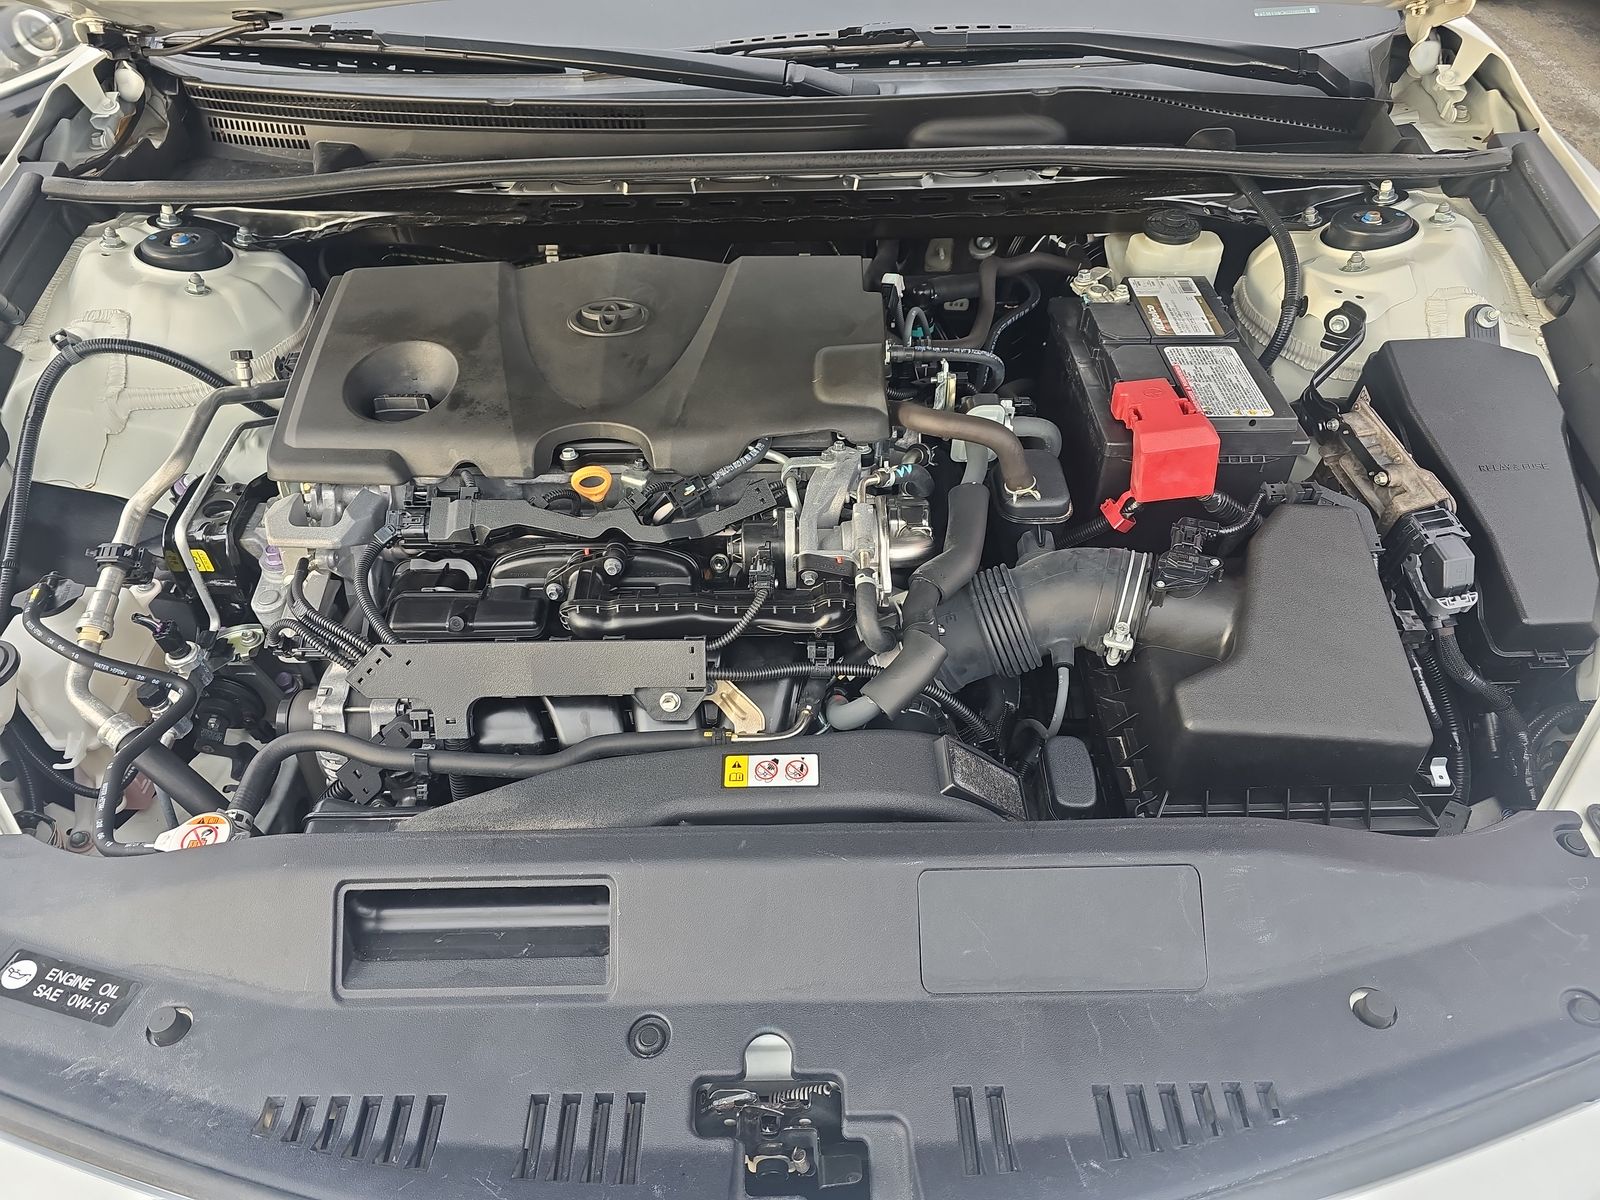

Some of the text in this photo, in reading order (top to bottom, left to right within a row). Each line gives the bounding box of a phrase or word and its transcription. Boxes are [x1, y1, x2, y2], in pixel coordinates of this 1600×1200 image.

[1478, 463, 1511, 472] RELAY
[1521, 462, 1550, 471] FUSE
[93, 662, 109, 672] WATER
[45, 968, 120, 999] ENGINE OIL
[33, 984, 110, 1015] SAE 0W-16
